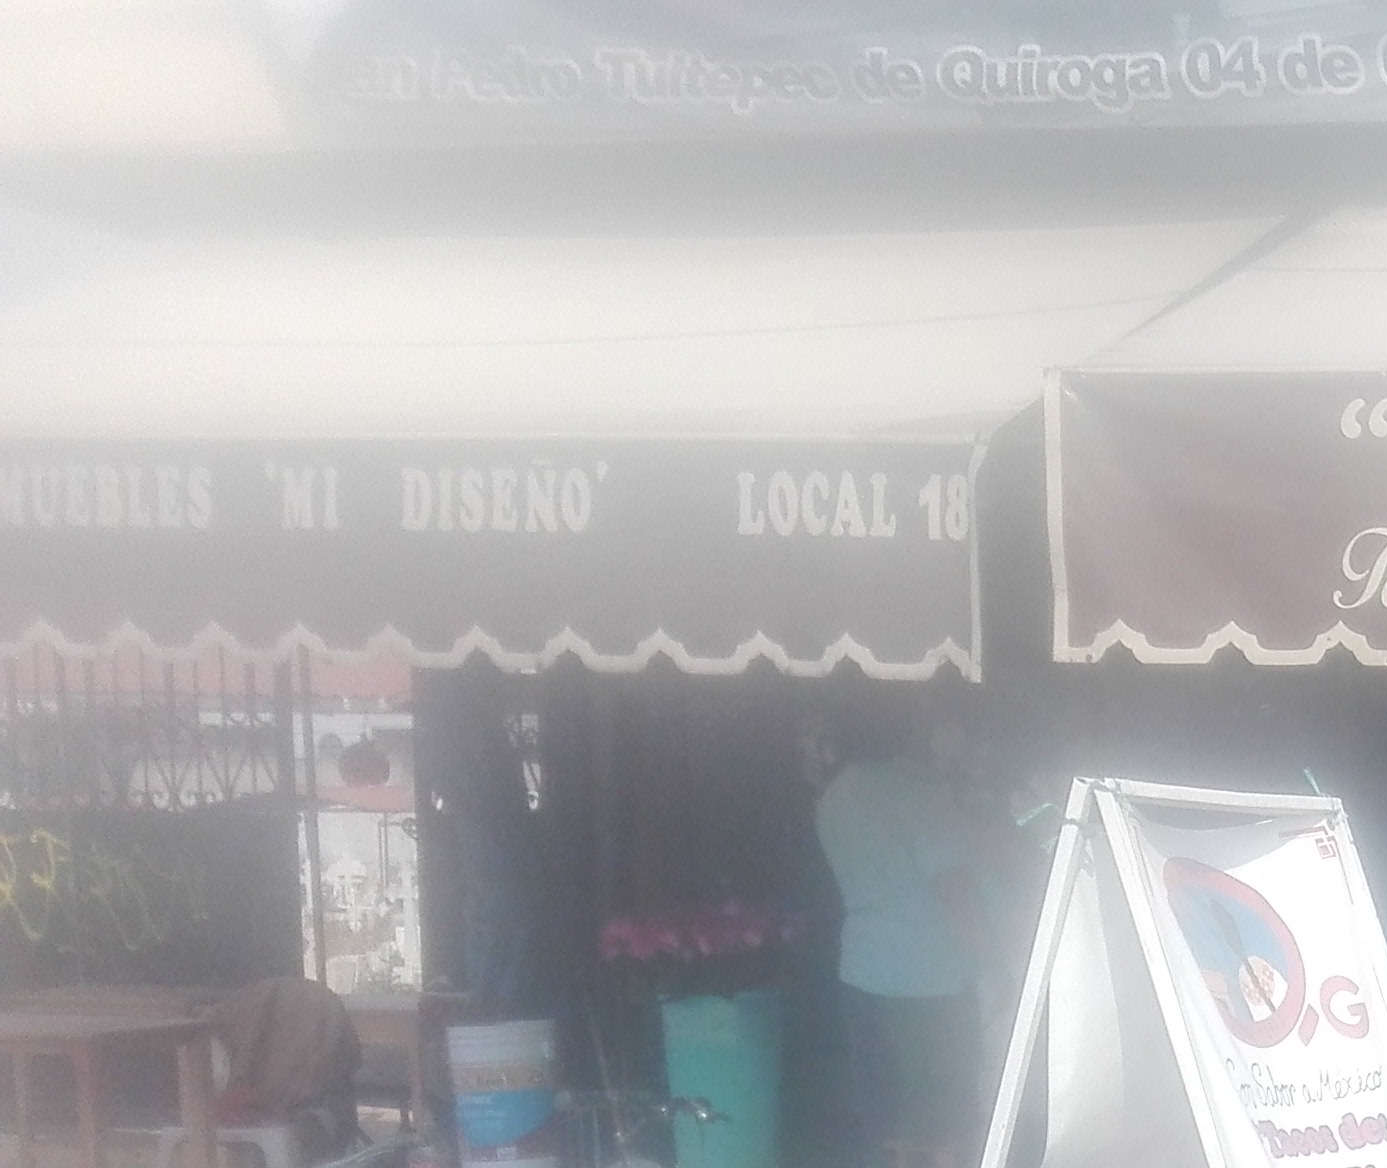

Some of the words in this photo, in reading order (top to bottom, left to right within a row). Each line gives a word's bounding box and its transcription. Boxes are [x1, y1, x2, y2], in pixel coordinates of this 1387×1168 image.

[850, 45, 924, 103] de
[936, 44, 1170, 112] Quiroga
[1181, 36, 1267, 98] 04
[1279, 31, 1364, 96] de
[737, 470, 896, 538] LOCAL
[919, 473, 970, 543] 18
